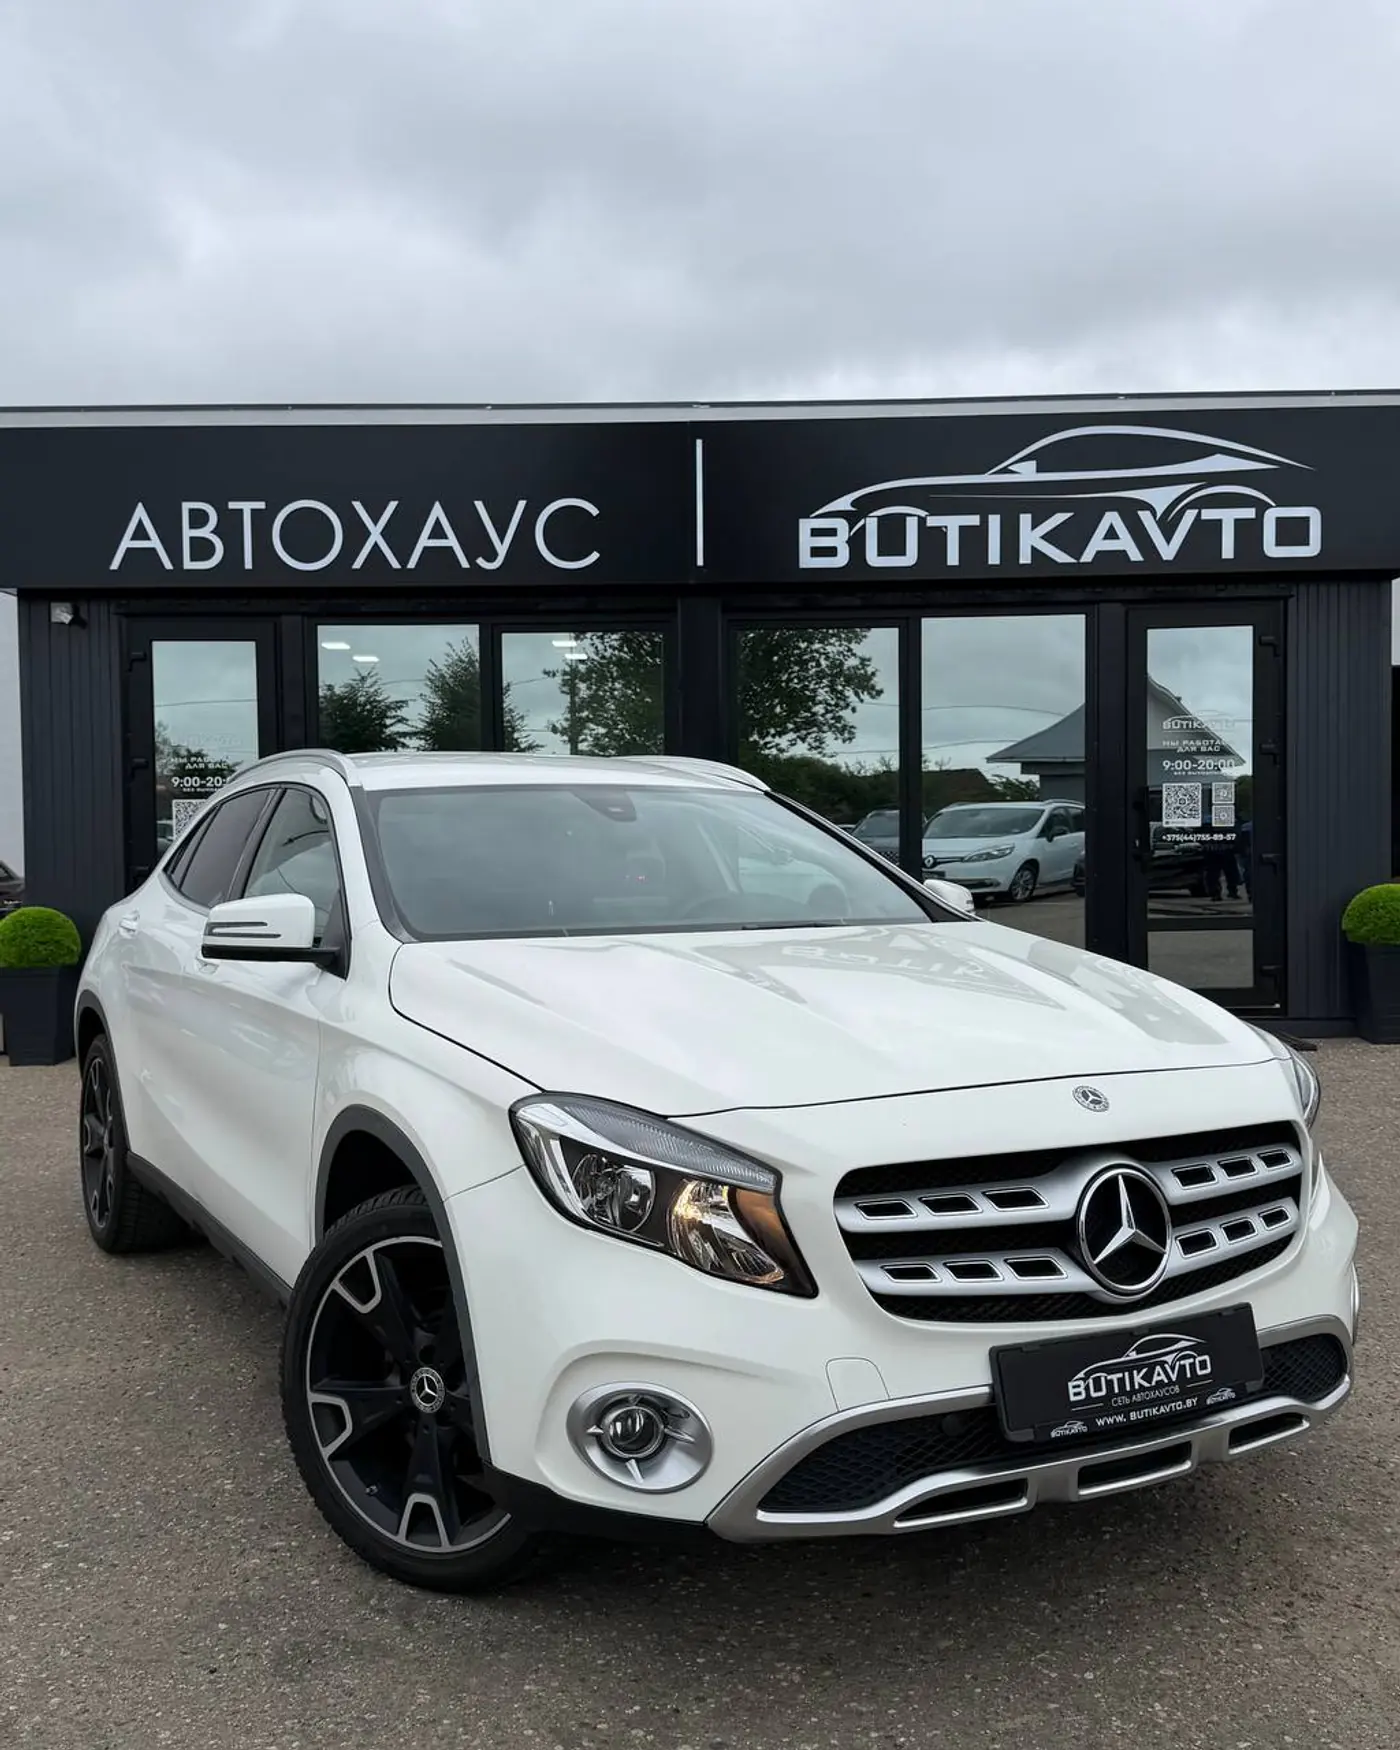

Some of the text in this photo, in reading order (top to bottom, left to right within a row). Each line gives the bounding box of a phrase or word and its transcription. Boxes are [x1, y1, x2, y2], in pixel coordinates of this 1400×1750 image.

[109, 497, 601, 572] АВТОХАУС
[799, 505, 1323, 569] BUTIKAVTO
[171, 776, 230, 788] 9:00-20:
[1067, 1354, 1212, 1402] BUTIKAVTO
[1129, 1397, 1198, 1421] BUTIKAVTO.BY
